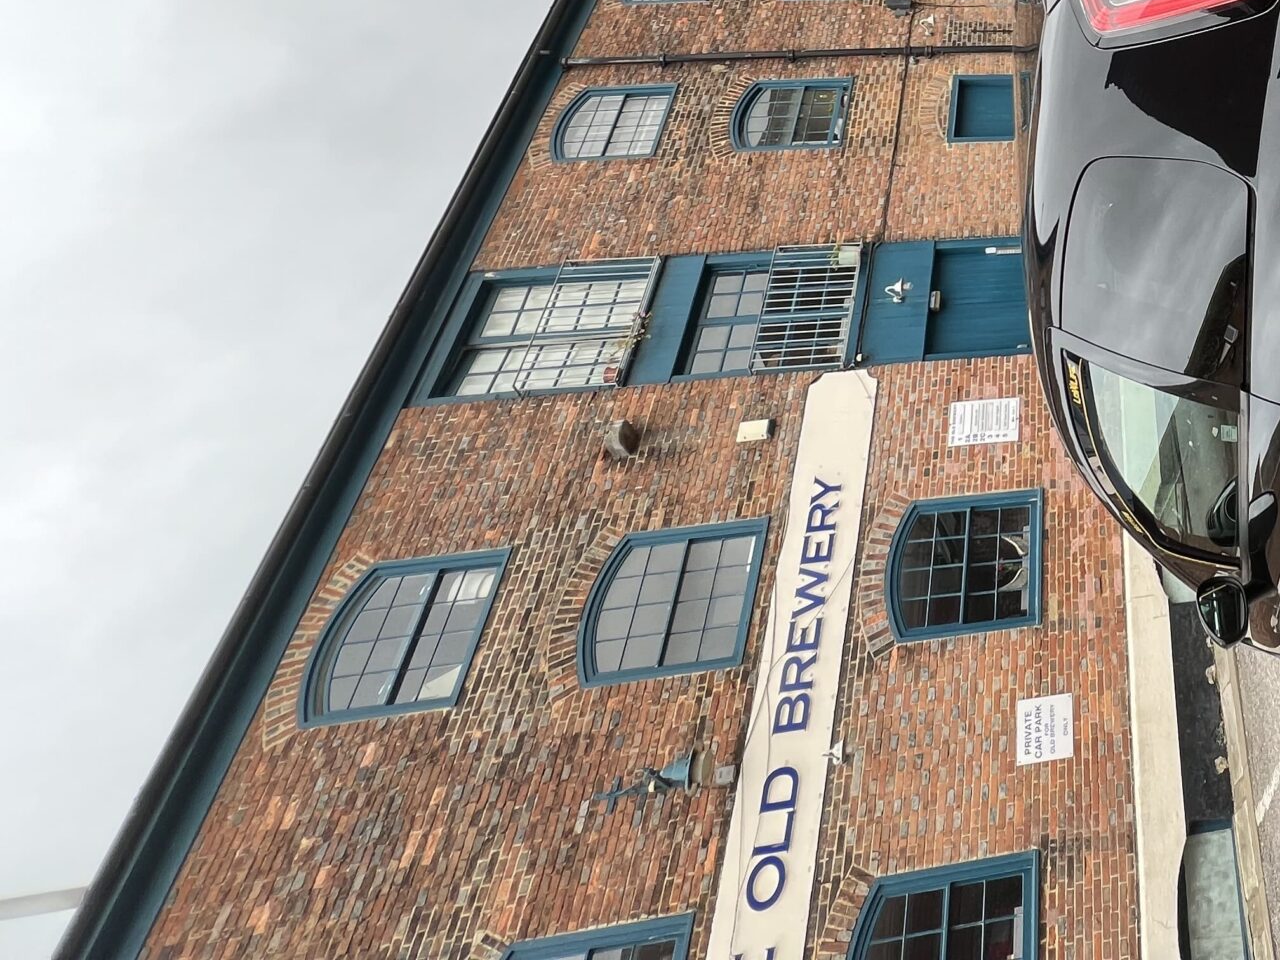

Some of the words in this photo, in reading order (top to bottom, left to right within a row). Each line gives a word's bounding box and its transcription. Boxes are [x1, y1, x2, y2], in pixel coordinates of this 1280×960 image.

[980, 433, 986, 442] 2C
[745, 765, 799, 912] OLD
[772, 475, 842, 735] BREWERY
[1024, 711, 1032, 755] PRIVATE
[1034, 736, 1042, 758] CAR
